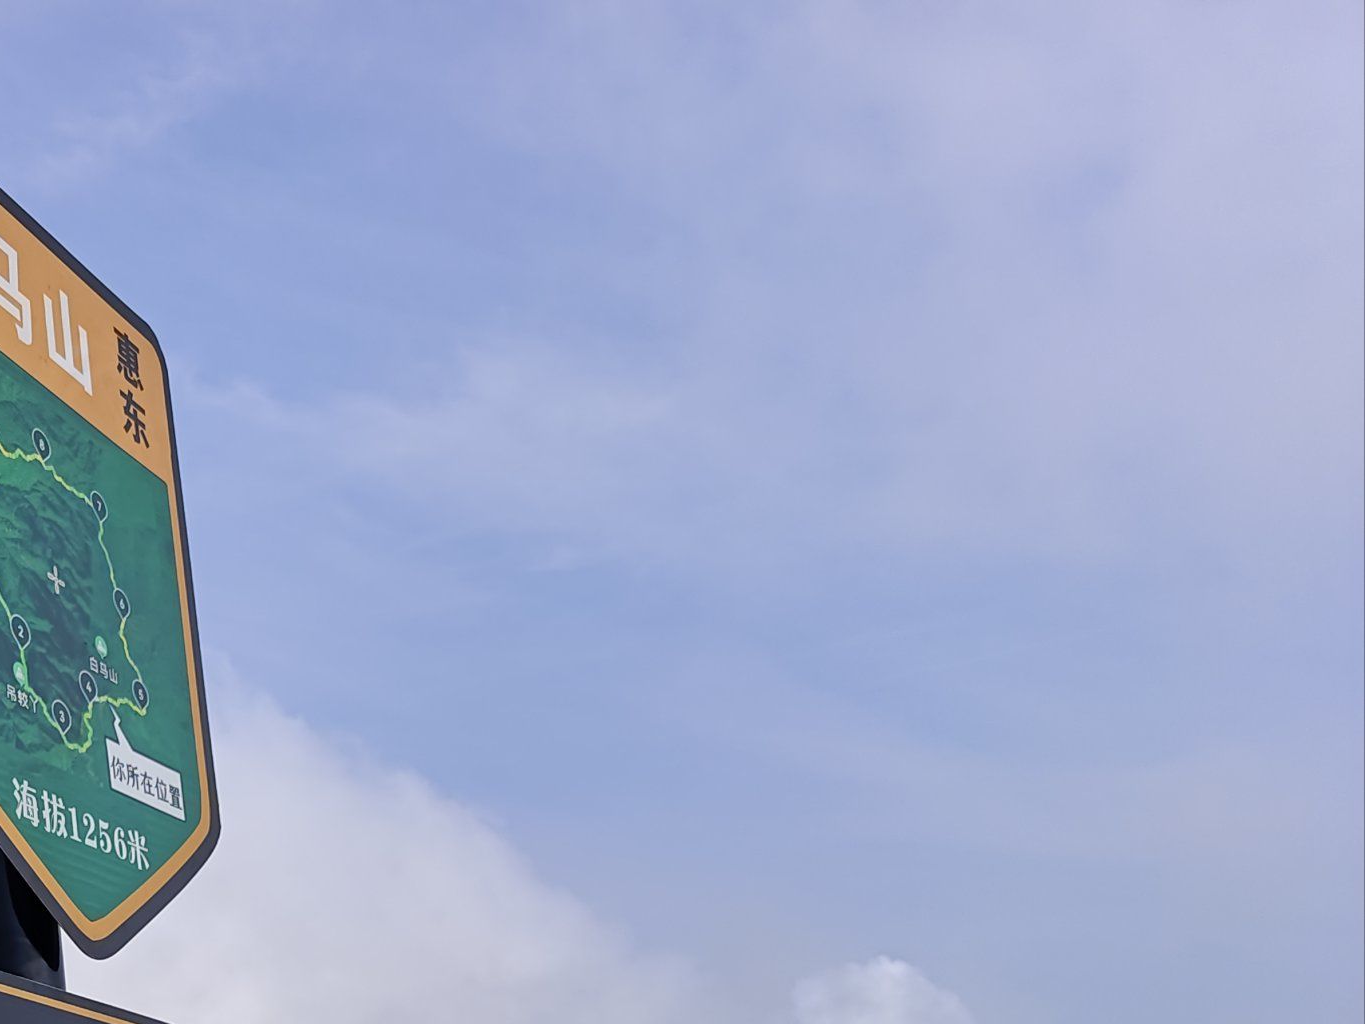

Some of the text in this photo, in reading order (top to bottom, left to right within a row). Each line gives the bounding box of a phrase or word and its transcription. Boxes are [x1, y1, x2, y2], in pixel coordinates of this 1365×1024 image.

[113, 326, 150, 449] 惠东
[18, 625, 24, 638] 2
[89, 657, 119, 685] 白马山
[59, 710, 66, 723] 3
[111, 755, 183, 811] 你所在位置
[12, 777, 150, 871] 海拔1256米
